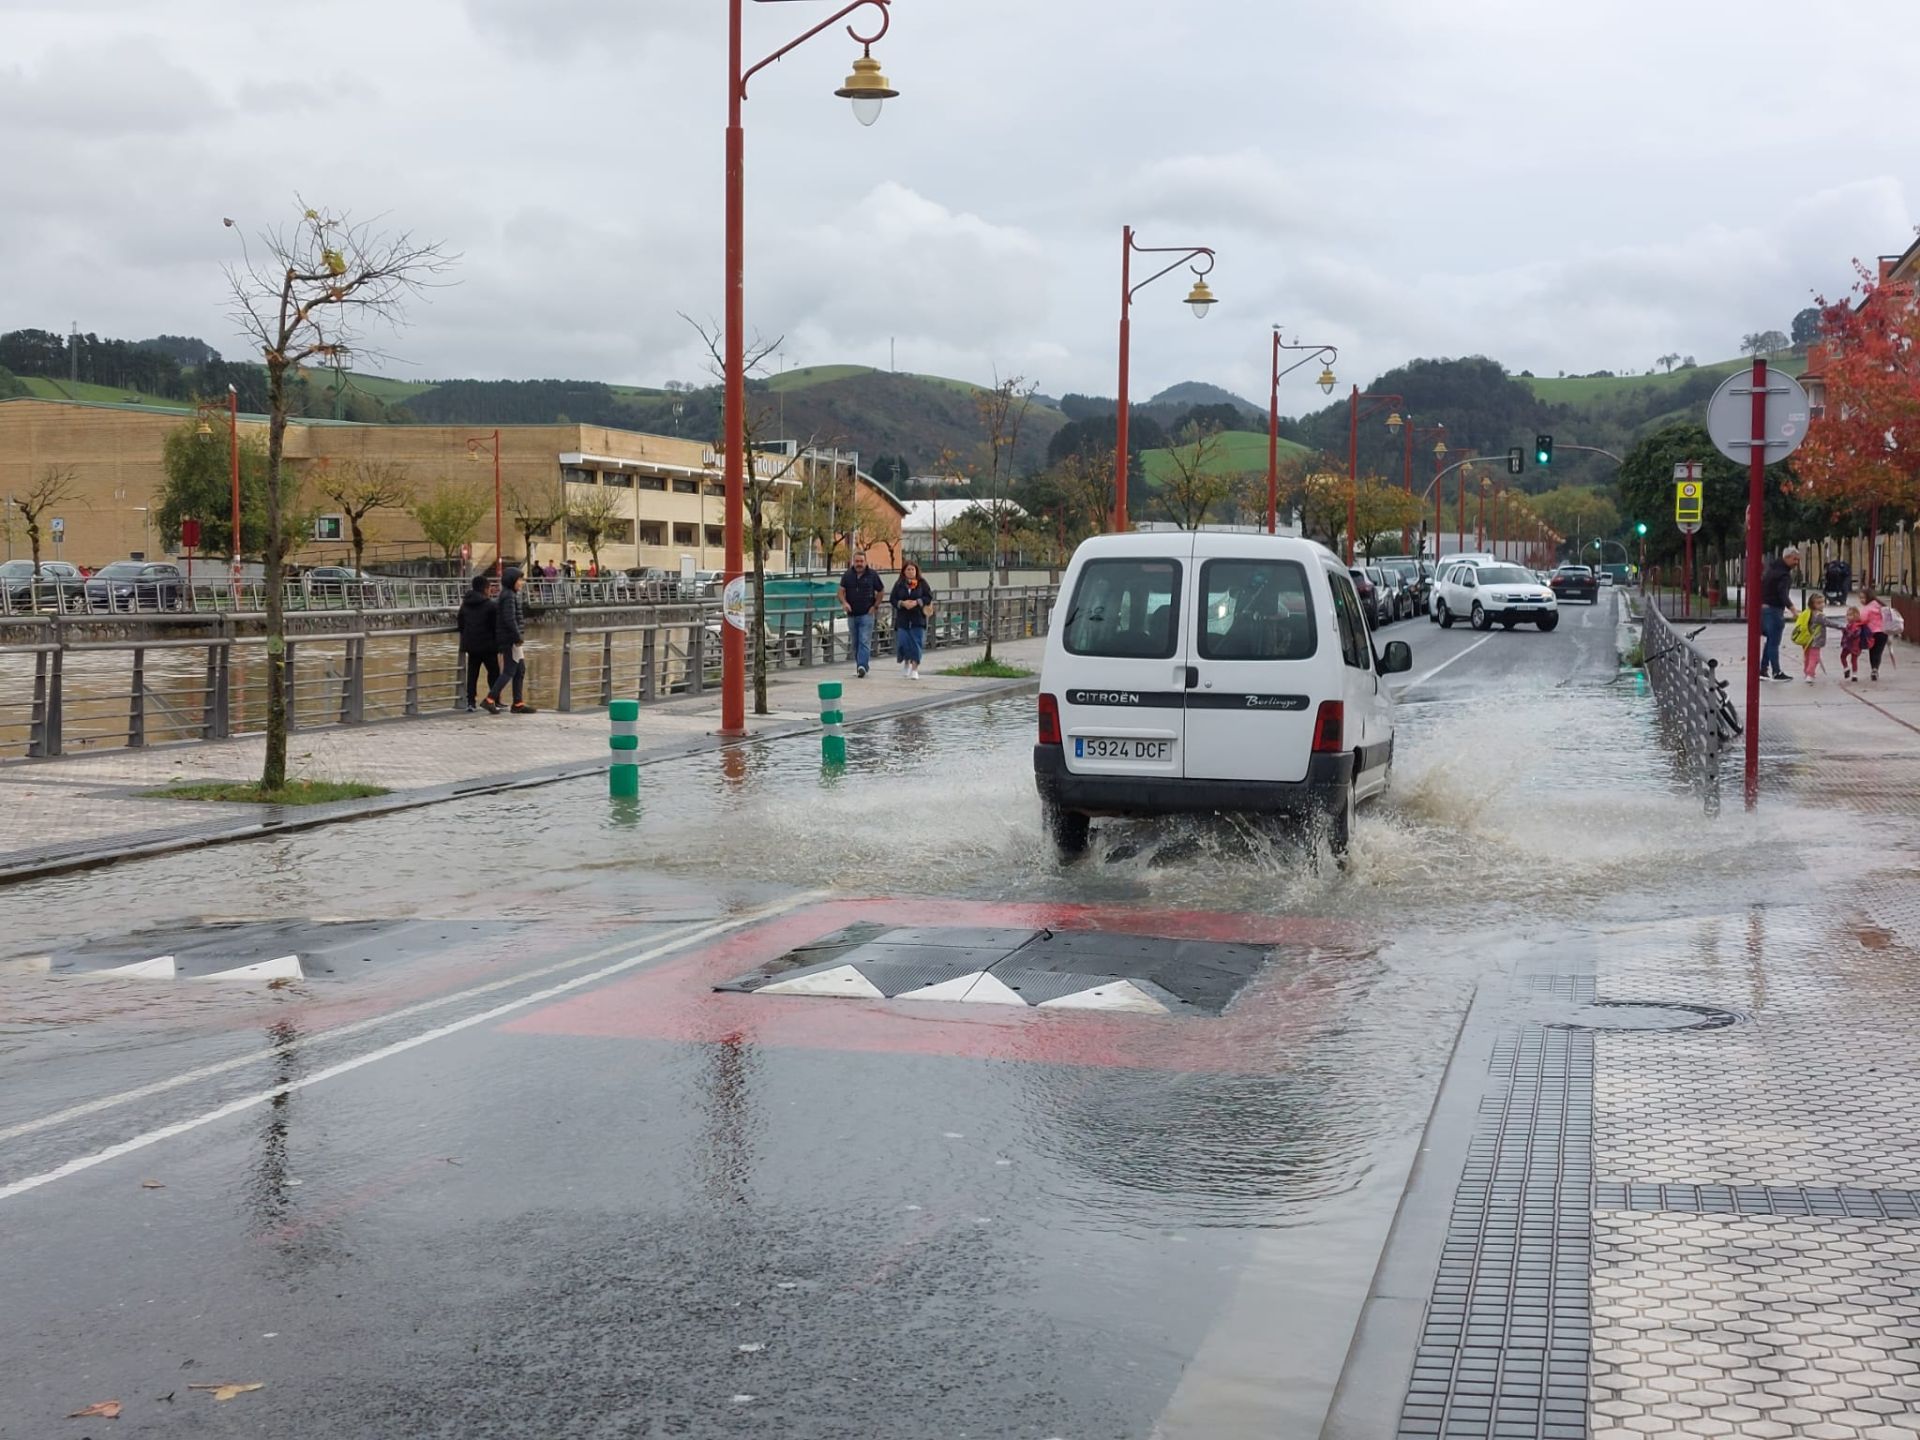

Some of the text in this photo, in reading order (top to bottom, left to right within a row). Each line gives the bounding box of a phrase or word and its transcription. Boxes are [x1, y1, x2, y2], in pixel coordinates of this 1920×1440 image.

[1076, 691, 1139, 704] CITROËN
[1245, 695, 1297, 709] Berlingo
[1087, 740, 1168, 758] 5924 DCF
